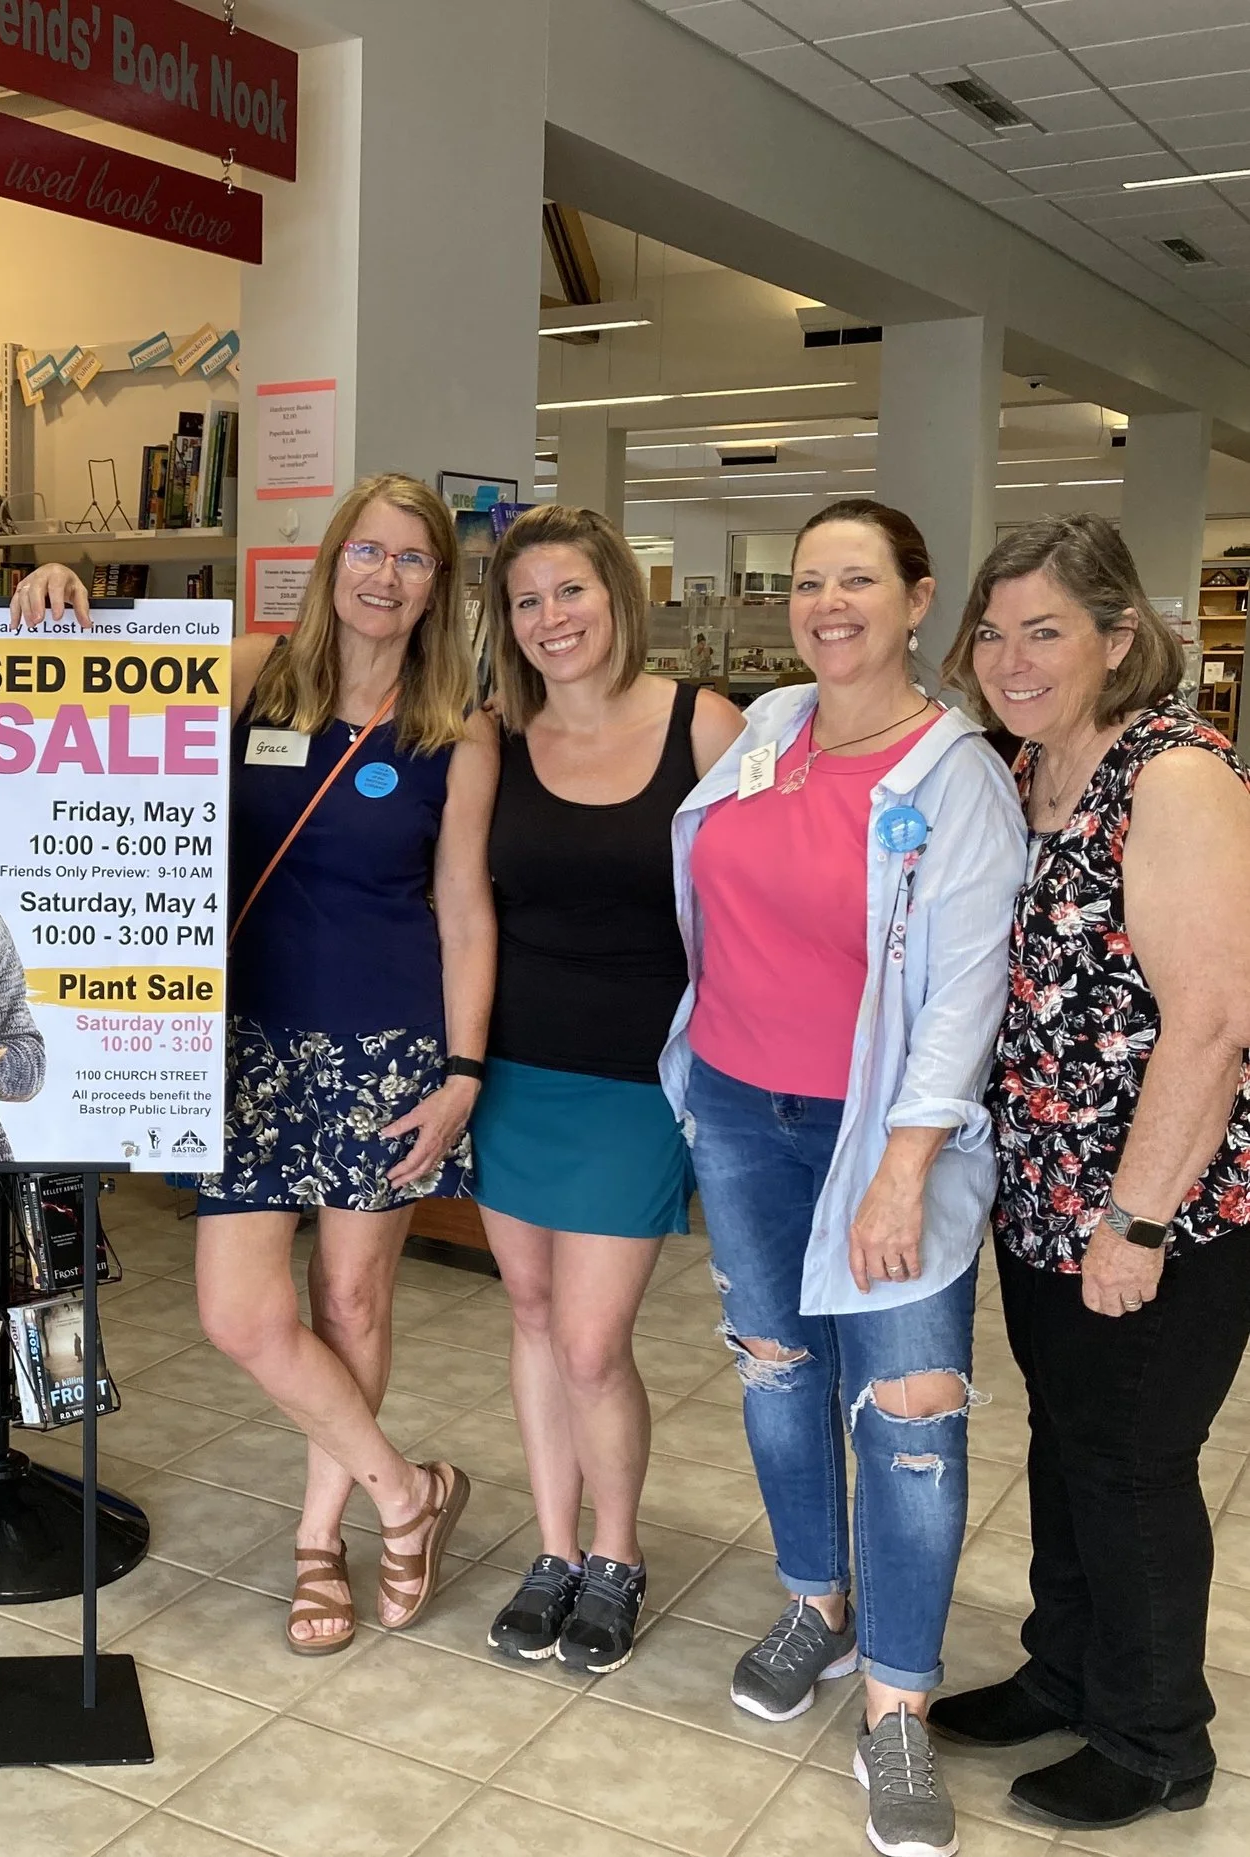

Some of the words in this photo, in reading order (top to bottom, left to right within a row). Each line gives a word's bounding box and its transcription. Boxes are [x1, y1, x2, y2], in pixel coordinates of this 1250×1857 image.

[113, 14, 199, 111] Book
[210, 53, 288, 144] Nook
[4, 156, 86, 203] used
[87, 159, 161, 225] book
[165, 196, 232, 245] store
[134, 341, 170, 365] Decorating
[177, 332, 213, 367] Remodeling
[76, 358, 95, 381] Culture
[204, 350, 232, 373] Building
[44, 621, 76, 634] Lost
[126, 622, 180, 635] Garden
[185, 622, 220, 635] Club
[83, 656, 219, 694] BOOK
[256, 741, 289, 755] Grace
[52, 800, 135, 826] Friday,
[144, 801, 194, 826] May
[201, 802, 216, 822] 3
[30, 835, 93, 855] 10:00
[116, 835, 166, 855] 6:00
[175, 836, 212, 856] PM
[0, 865, 51, 878] Friends
[56, 866, 88, 881] Only
[92, 866, 149, 878] Preview:
[158, 867, 186, 879] 9-10
[190, 868, 212, 879] AM
[20, 891, 136, 916] Saturday,
[145, 892, 196, 917] May
[203, 893, 217, 912] 4
[32, 925, 95, 945] 10:00
[118, 925, 168, 945] 3:00
[177, 926, 214, 946] PM
[59, 974, 136, 1000] Plant
[147, 974, 213, 1001] Sale
[76, 1015, 164, 1035] Saturday
[172, 1016, 213, 1035] only
[101, 1036, 153, 1051] 10:00
[172, 1036, 213, 1052] 3:00
[75, 1071, 101, 1080] 1100
[104, 1070, 157, 1081] CHURCH
[161, 1070, 207, 1081] STREET
[72, 1090, 88, 1100] All
[92, 1090, 146, 1103] proceeds
[150, 1090, 191, 1101] benefit
[194, 1091, 211, 1101] the
[80, 1105, 125, 1117] Bastrop
[130, 1105, 166, 1115] Public
[170, 1105, 211, 1118] Library
[42, 1187, 63, 1196] KELLEY
[26, 1322, 39, 1362] FROST
